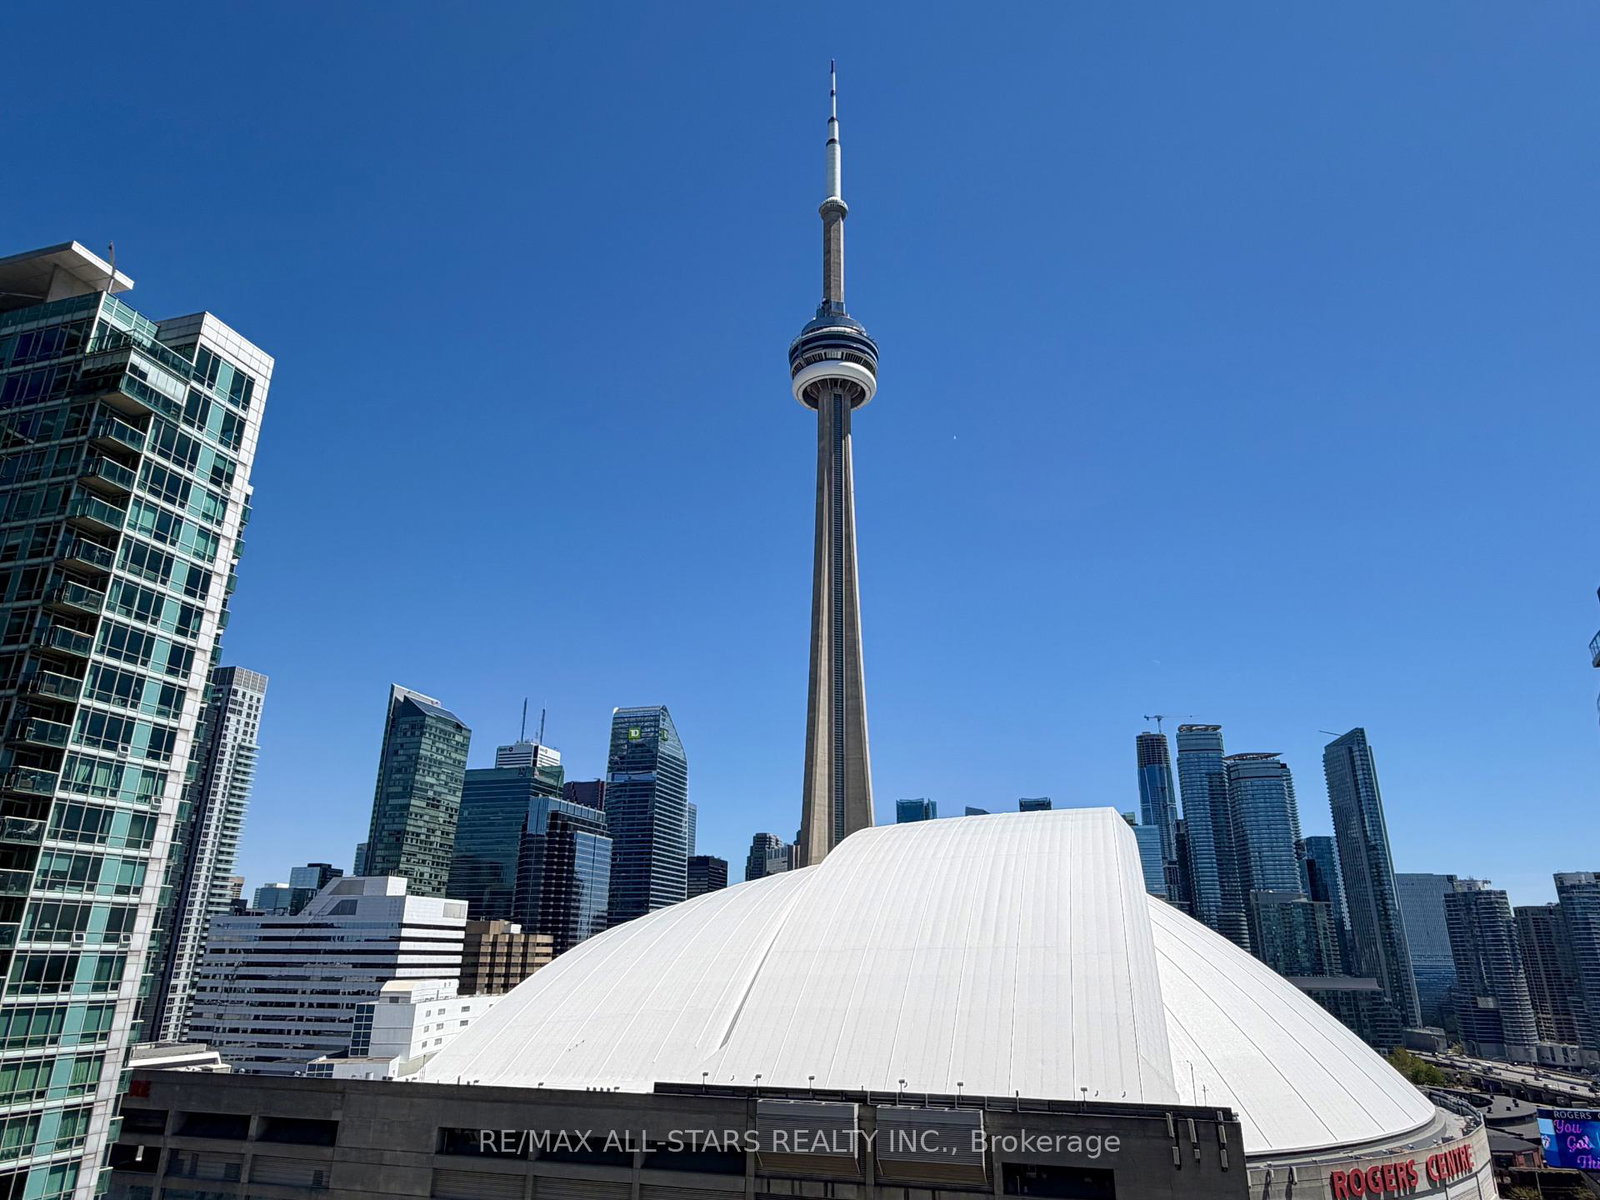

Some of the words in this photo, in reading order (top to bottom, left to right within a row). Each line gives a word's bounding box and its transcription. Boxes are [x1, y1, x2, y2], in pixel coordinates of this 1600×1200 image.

[1553, 1110, 1592, 1120] ROGERS
[1553, 1119, 1582, 1134] You
[1332, 1159, 1419, 1200] ROGERS
[1426, 1144, 1475, 1181] CENTRE
